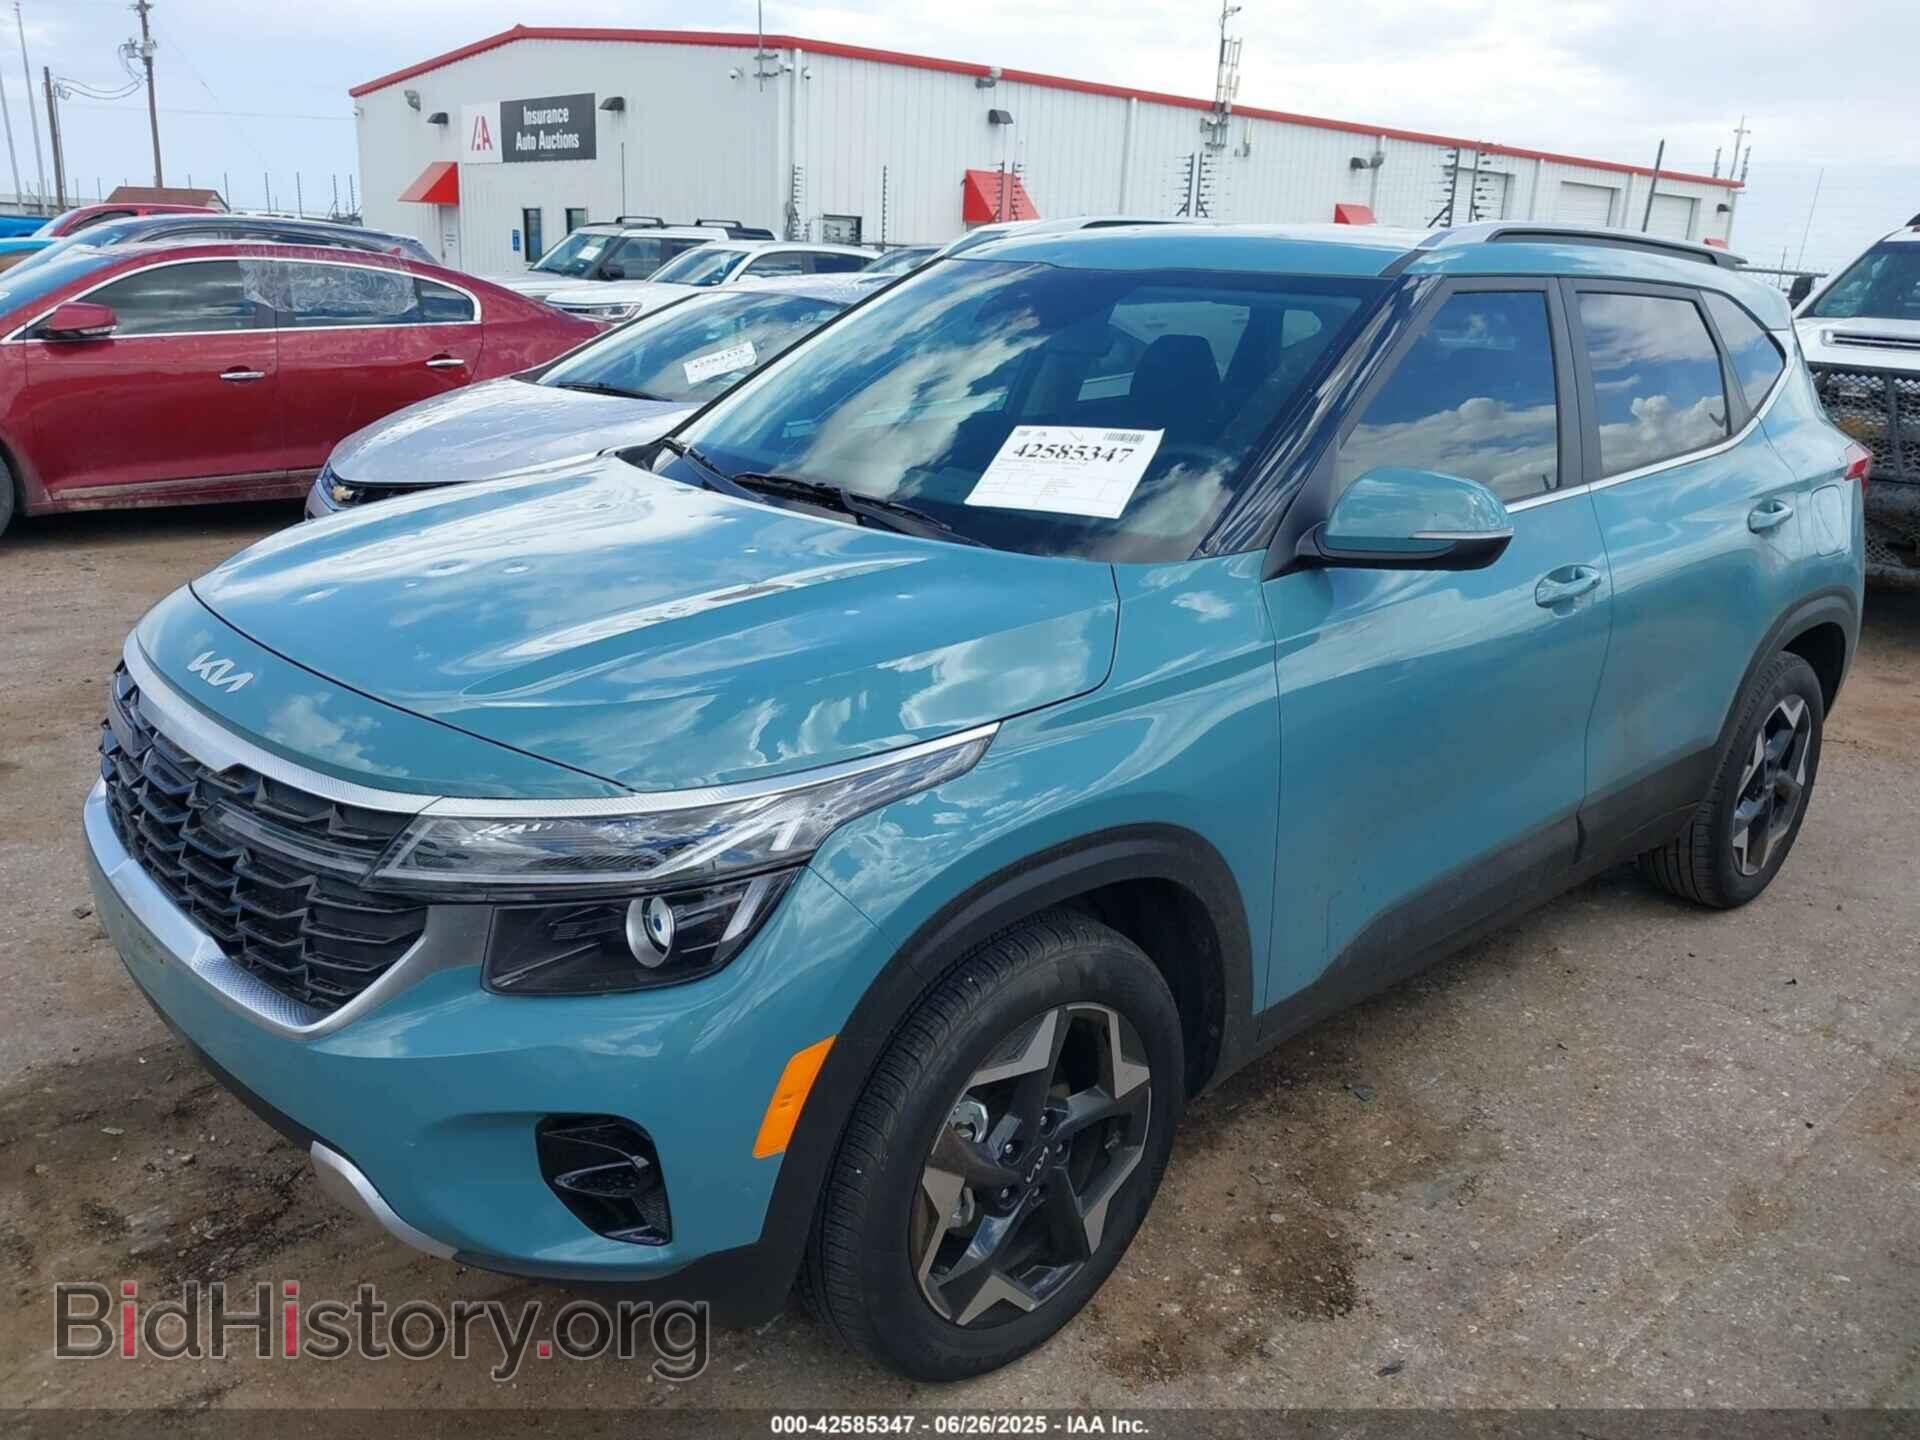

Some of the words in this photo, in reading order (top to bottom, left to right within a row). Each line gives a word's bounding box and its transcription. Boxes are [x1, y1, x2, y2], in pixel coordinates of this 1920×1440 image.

[522, 105, 569, 126] Insurance
[515, 131, 537, 152] Auto
[538, 129, 580, 151] Auctions
[1012, 442, 1135, 464] 42585347
